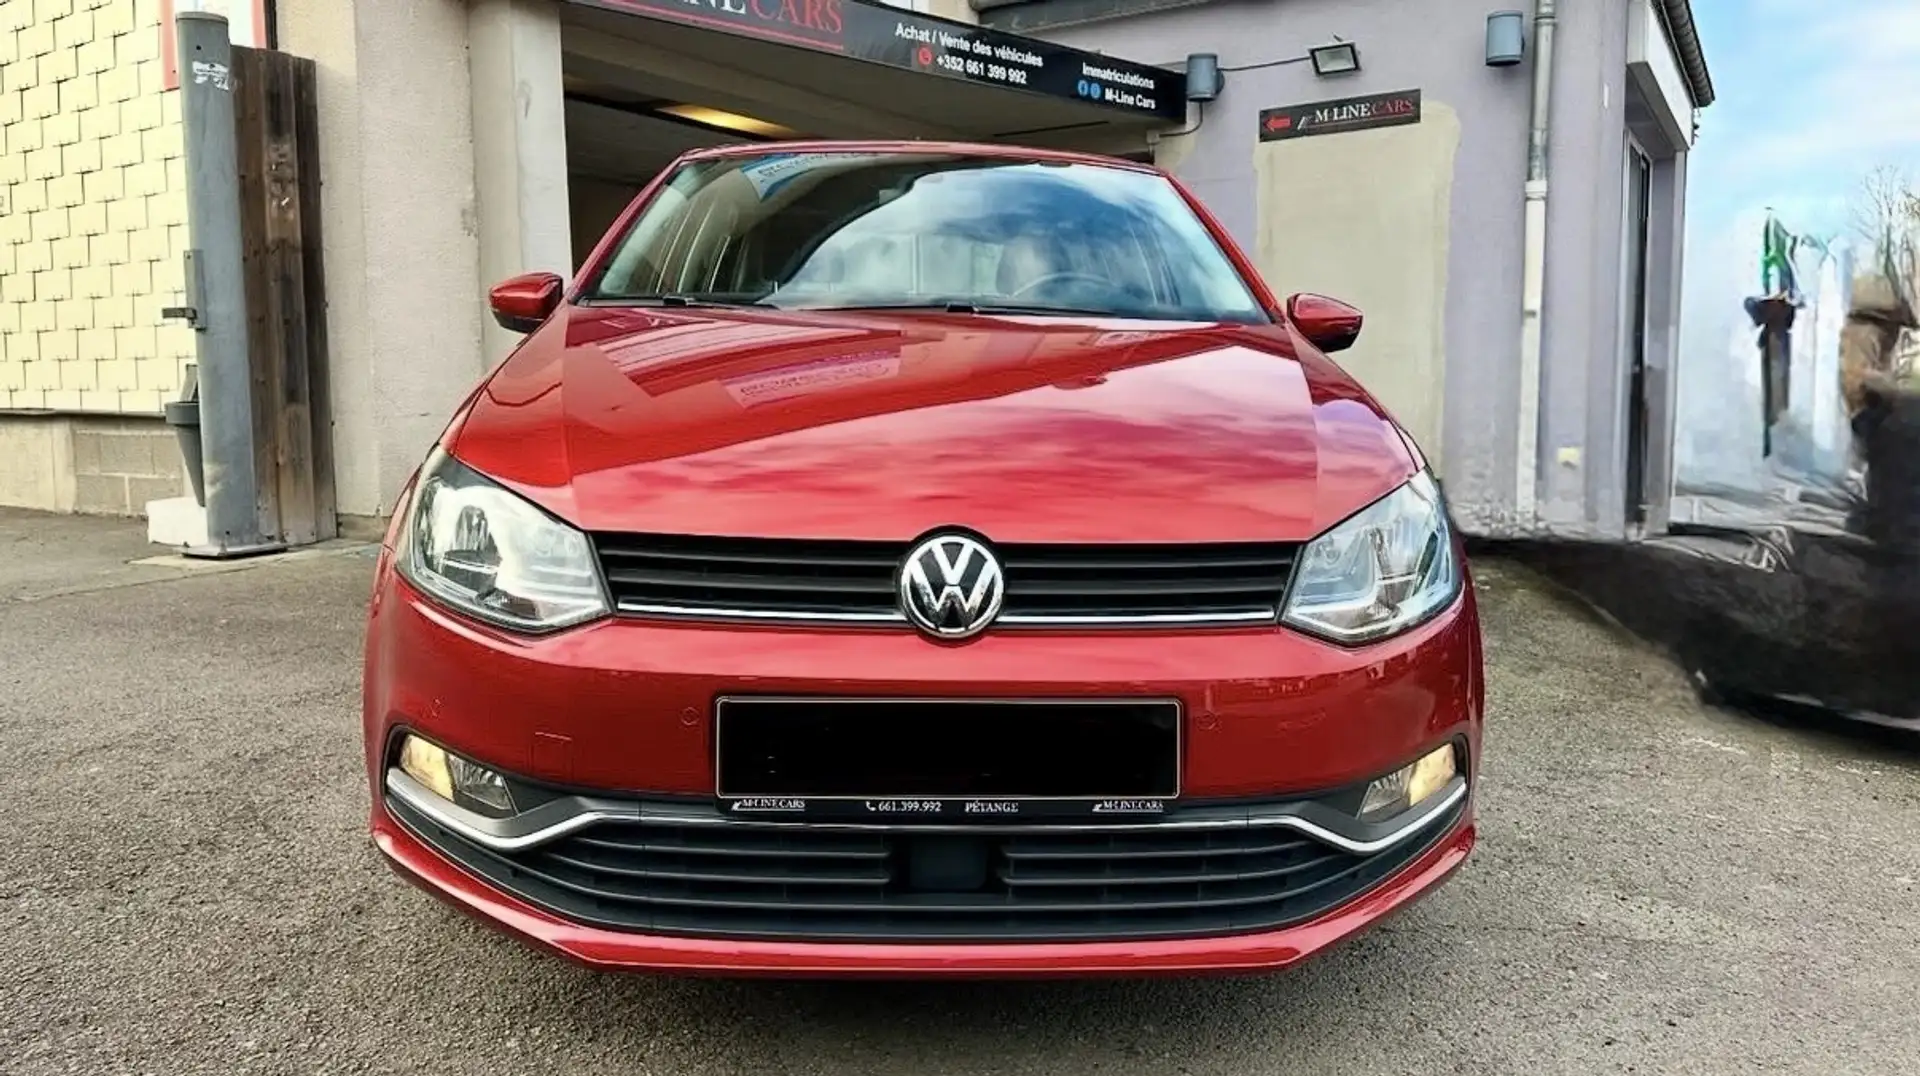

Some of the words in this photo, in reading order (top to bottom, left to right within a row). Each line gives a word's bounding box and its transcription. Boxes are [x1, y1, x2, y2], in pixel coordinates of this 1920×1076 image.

[895, 23, 930, 43] Achat
[938, 31, 970, 53] Vente
[972, 39, 992, 57] des
[993, 44, 1044, 67] véhicules
[936, 54, 964, 72] +352
[966, 59, 985, 76] 661
[987, 63, 1006, 81] 399
[1008, 68, 1027, 84] 992
[1082, 61, 1154, 89] Immatriculations
[1104, 87, 1134, 105] M-Line
[1135, 93, 1156, 109] Cars
[965, 800, 1019, 813] PÉTANGE
